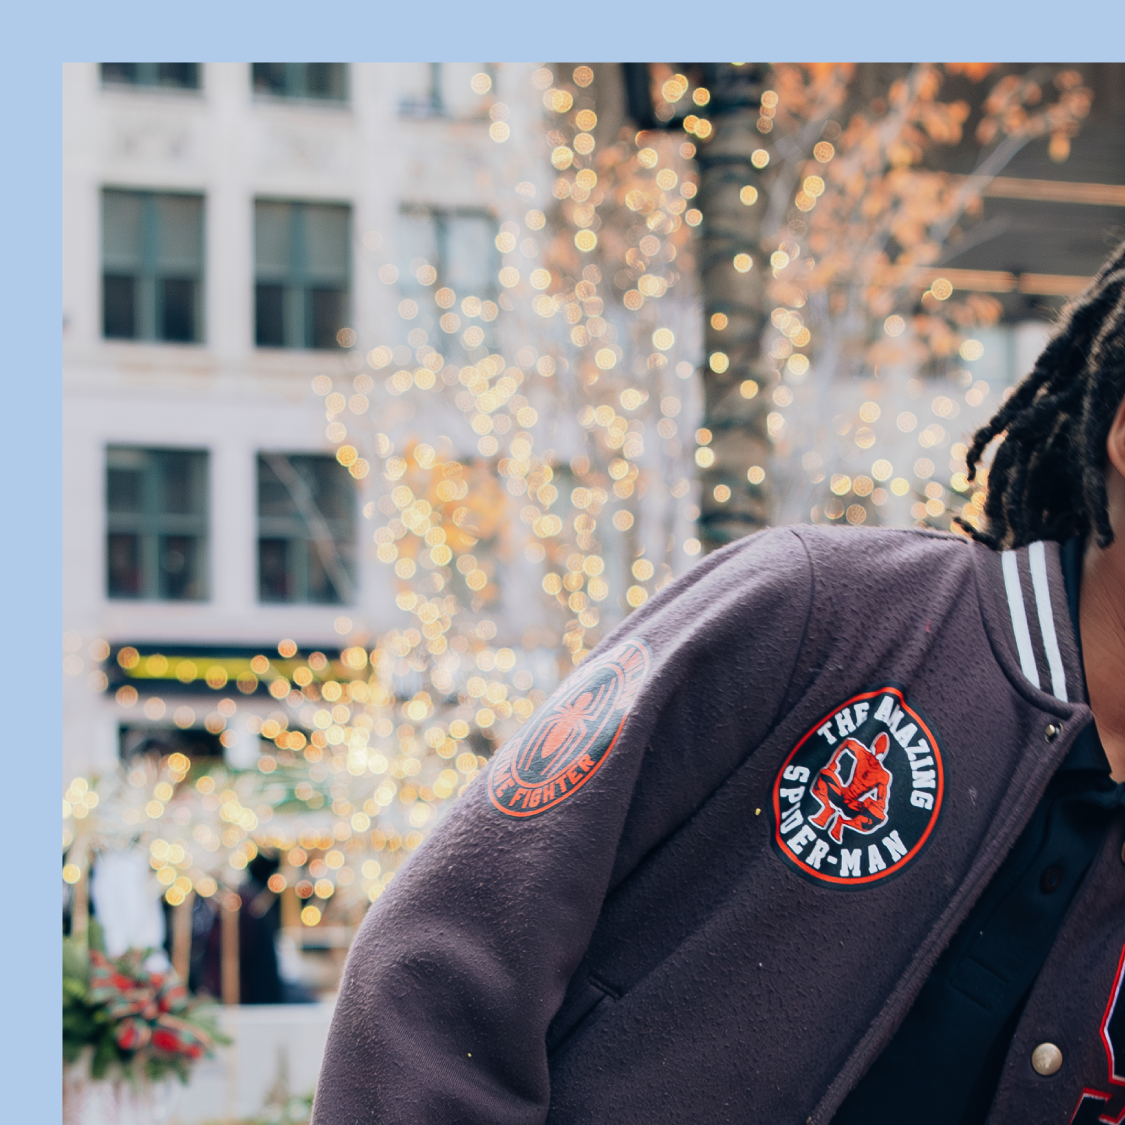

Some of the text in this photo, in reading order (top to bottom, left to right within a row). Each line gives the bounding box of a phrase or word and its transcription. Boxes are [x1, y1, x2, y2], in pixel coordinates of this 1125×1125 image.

[508, 754, 595, 809] FIGHTER
[817, 695, 936, 810] THE AMAZING
[779, 765, 908, 877] SPIDER-MAN
